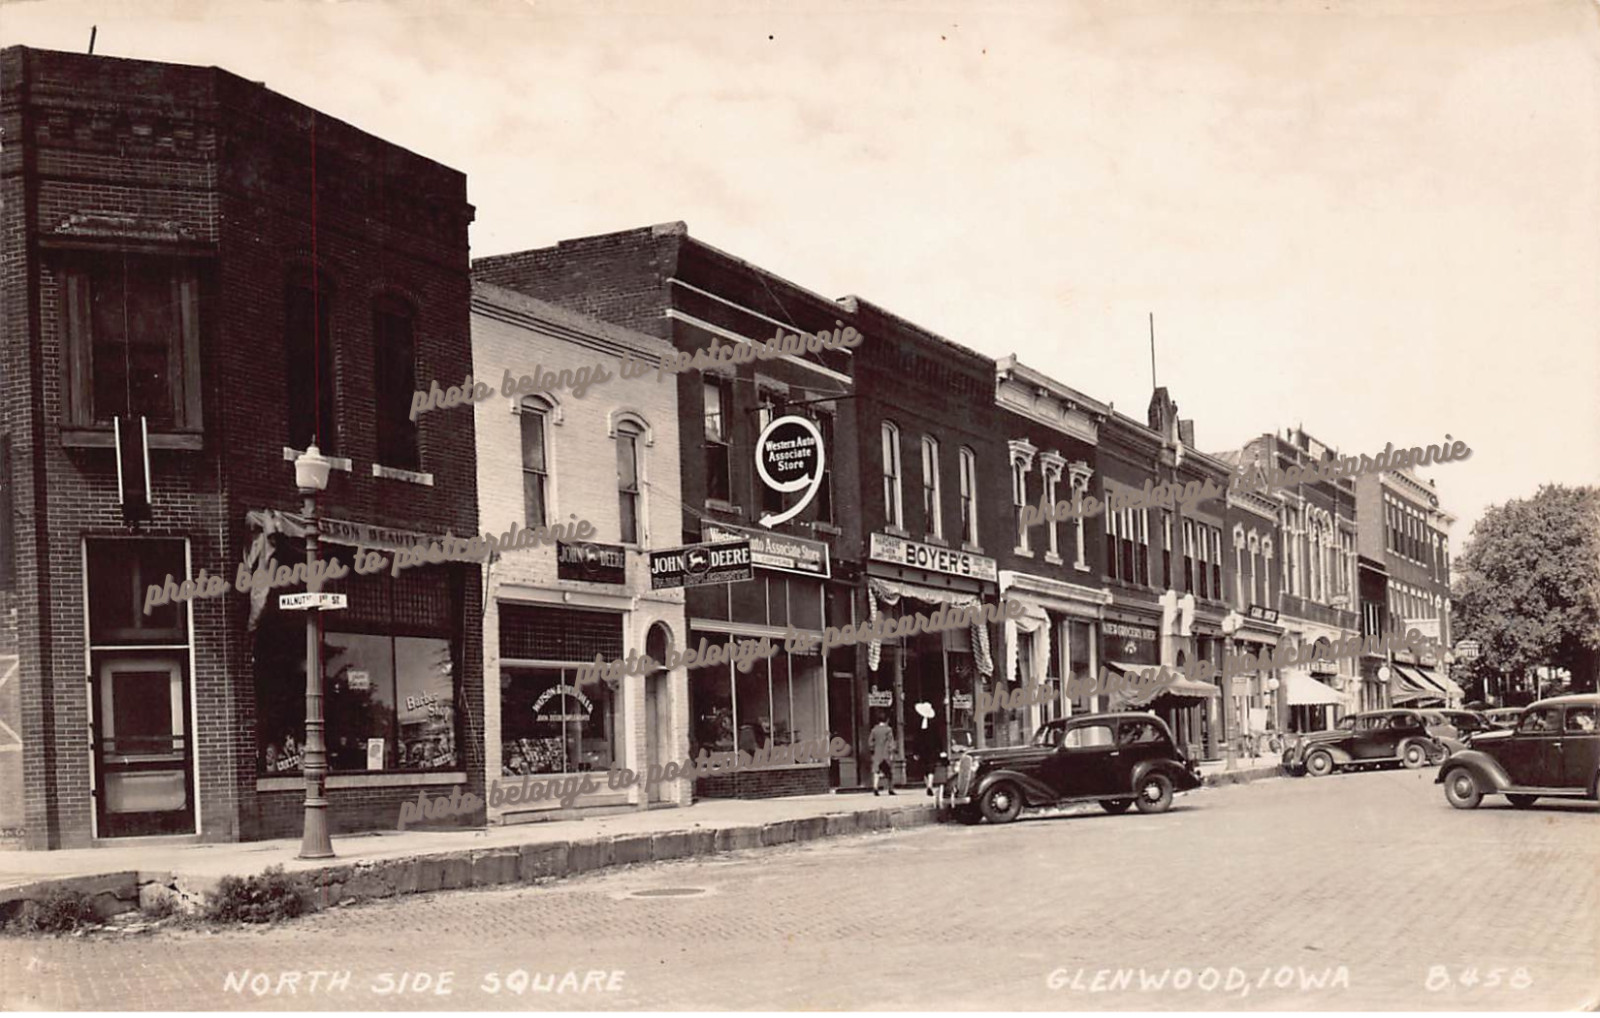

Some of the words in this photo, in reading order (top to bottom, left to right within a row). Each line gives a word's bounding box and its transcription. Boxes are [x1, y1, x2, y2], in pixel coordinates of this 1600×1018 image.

[765, 440, 795, 451] Western
[797, 436, 816, 447] Auto
[769, 448, 811, 462] Associate
[778, 460, 804, 471] Store
[559, 545, 584, 563] JOHN
[600, 550, 624, 568] DEERE
[765, 538, 800, 558] Associate
[801, 545, 820, 562] Store
[906, 544, 970, 574] BOYER'S
[652, 556, 685, 574] JOHN
[711, 548, 750, 567] DEERE
[428, 702, 451, 722] Shop
